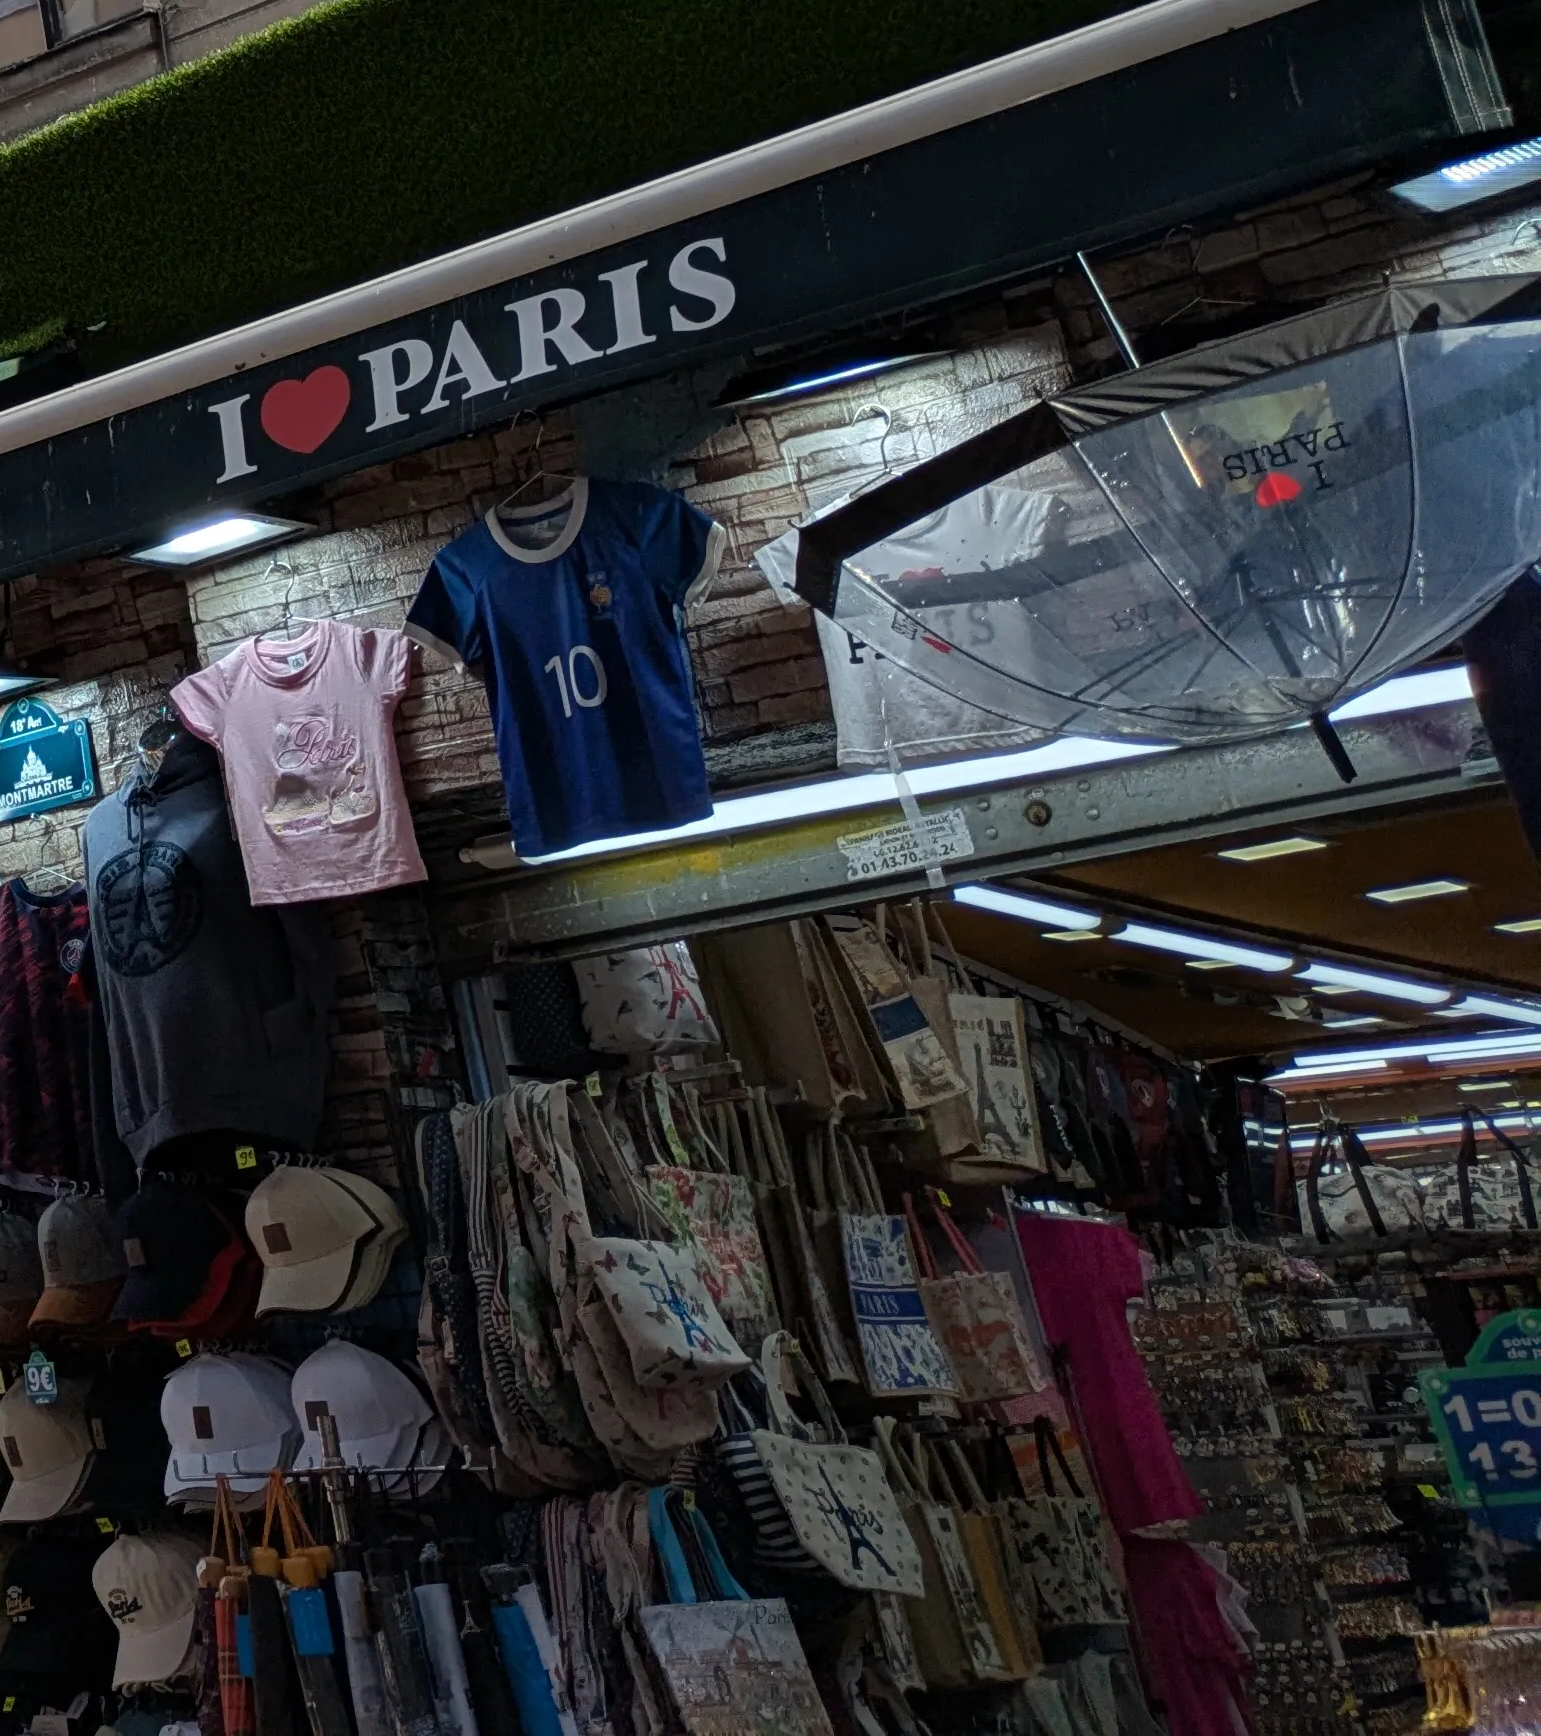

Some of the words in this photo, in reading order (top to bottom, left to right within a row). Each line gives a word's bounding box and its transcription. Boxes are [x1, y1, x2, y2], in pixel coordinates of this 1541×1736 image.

[209, 394, 257, 484] I
[359, 237, 737, 433] PARIS
[1222, 421, 1351, 481] PARIS
[545, 644, 608, 719] 10
[277, 718, 357, 769] Paris
[27, 1366, 54, 1392] 9€
